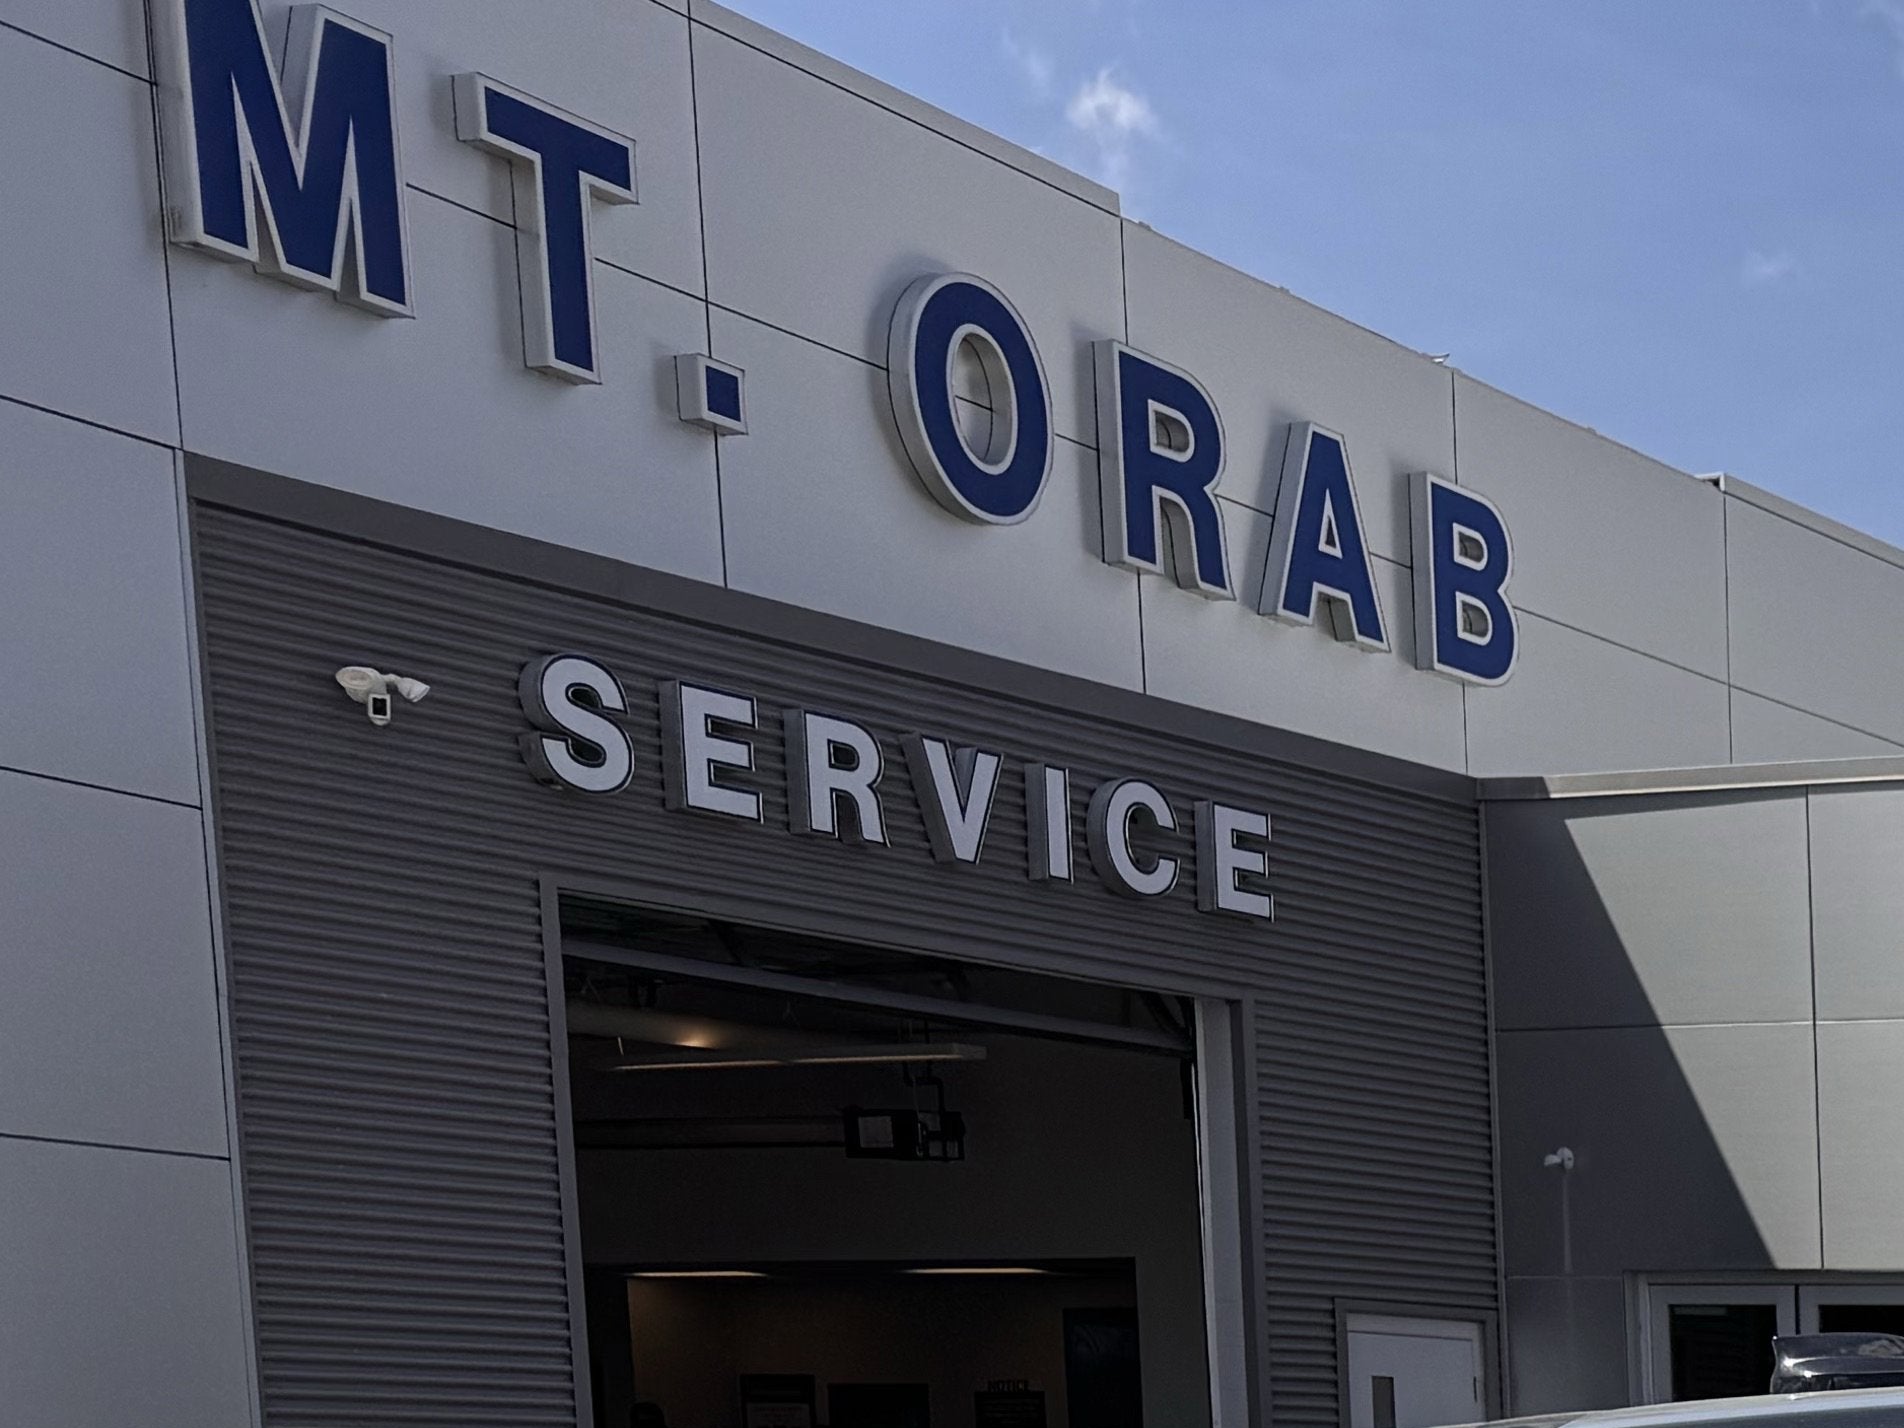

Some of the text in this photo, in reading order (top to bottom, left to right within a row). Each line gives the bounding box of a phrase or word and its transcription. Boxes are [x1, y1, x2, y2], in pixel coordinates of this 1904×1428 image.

[158, 0, 1521, 688] MT. ORAB
[517, 652, 1276, 924] SERVICE
